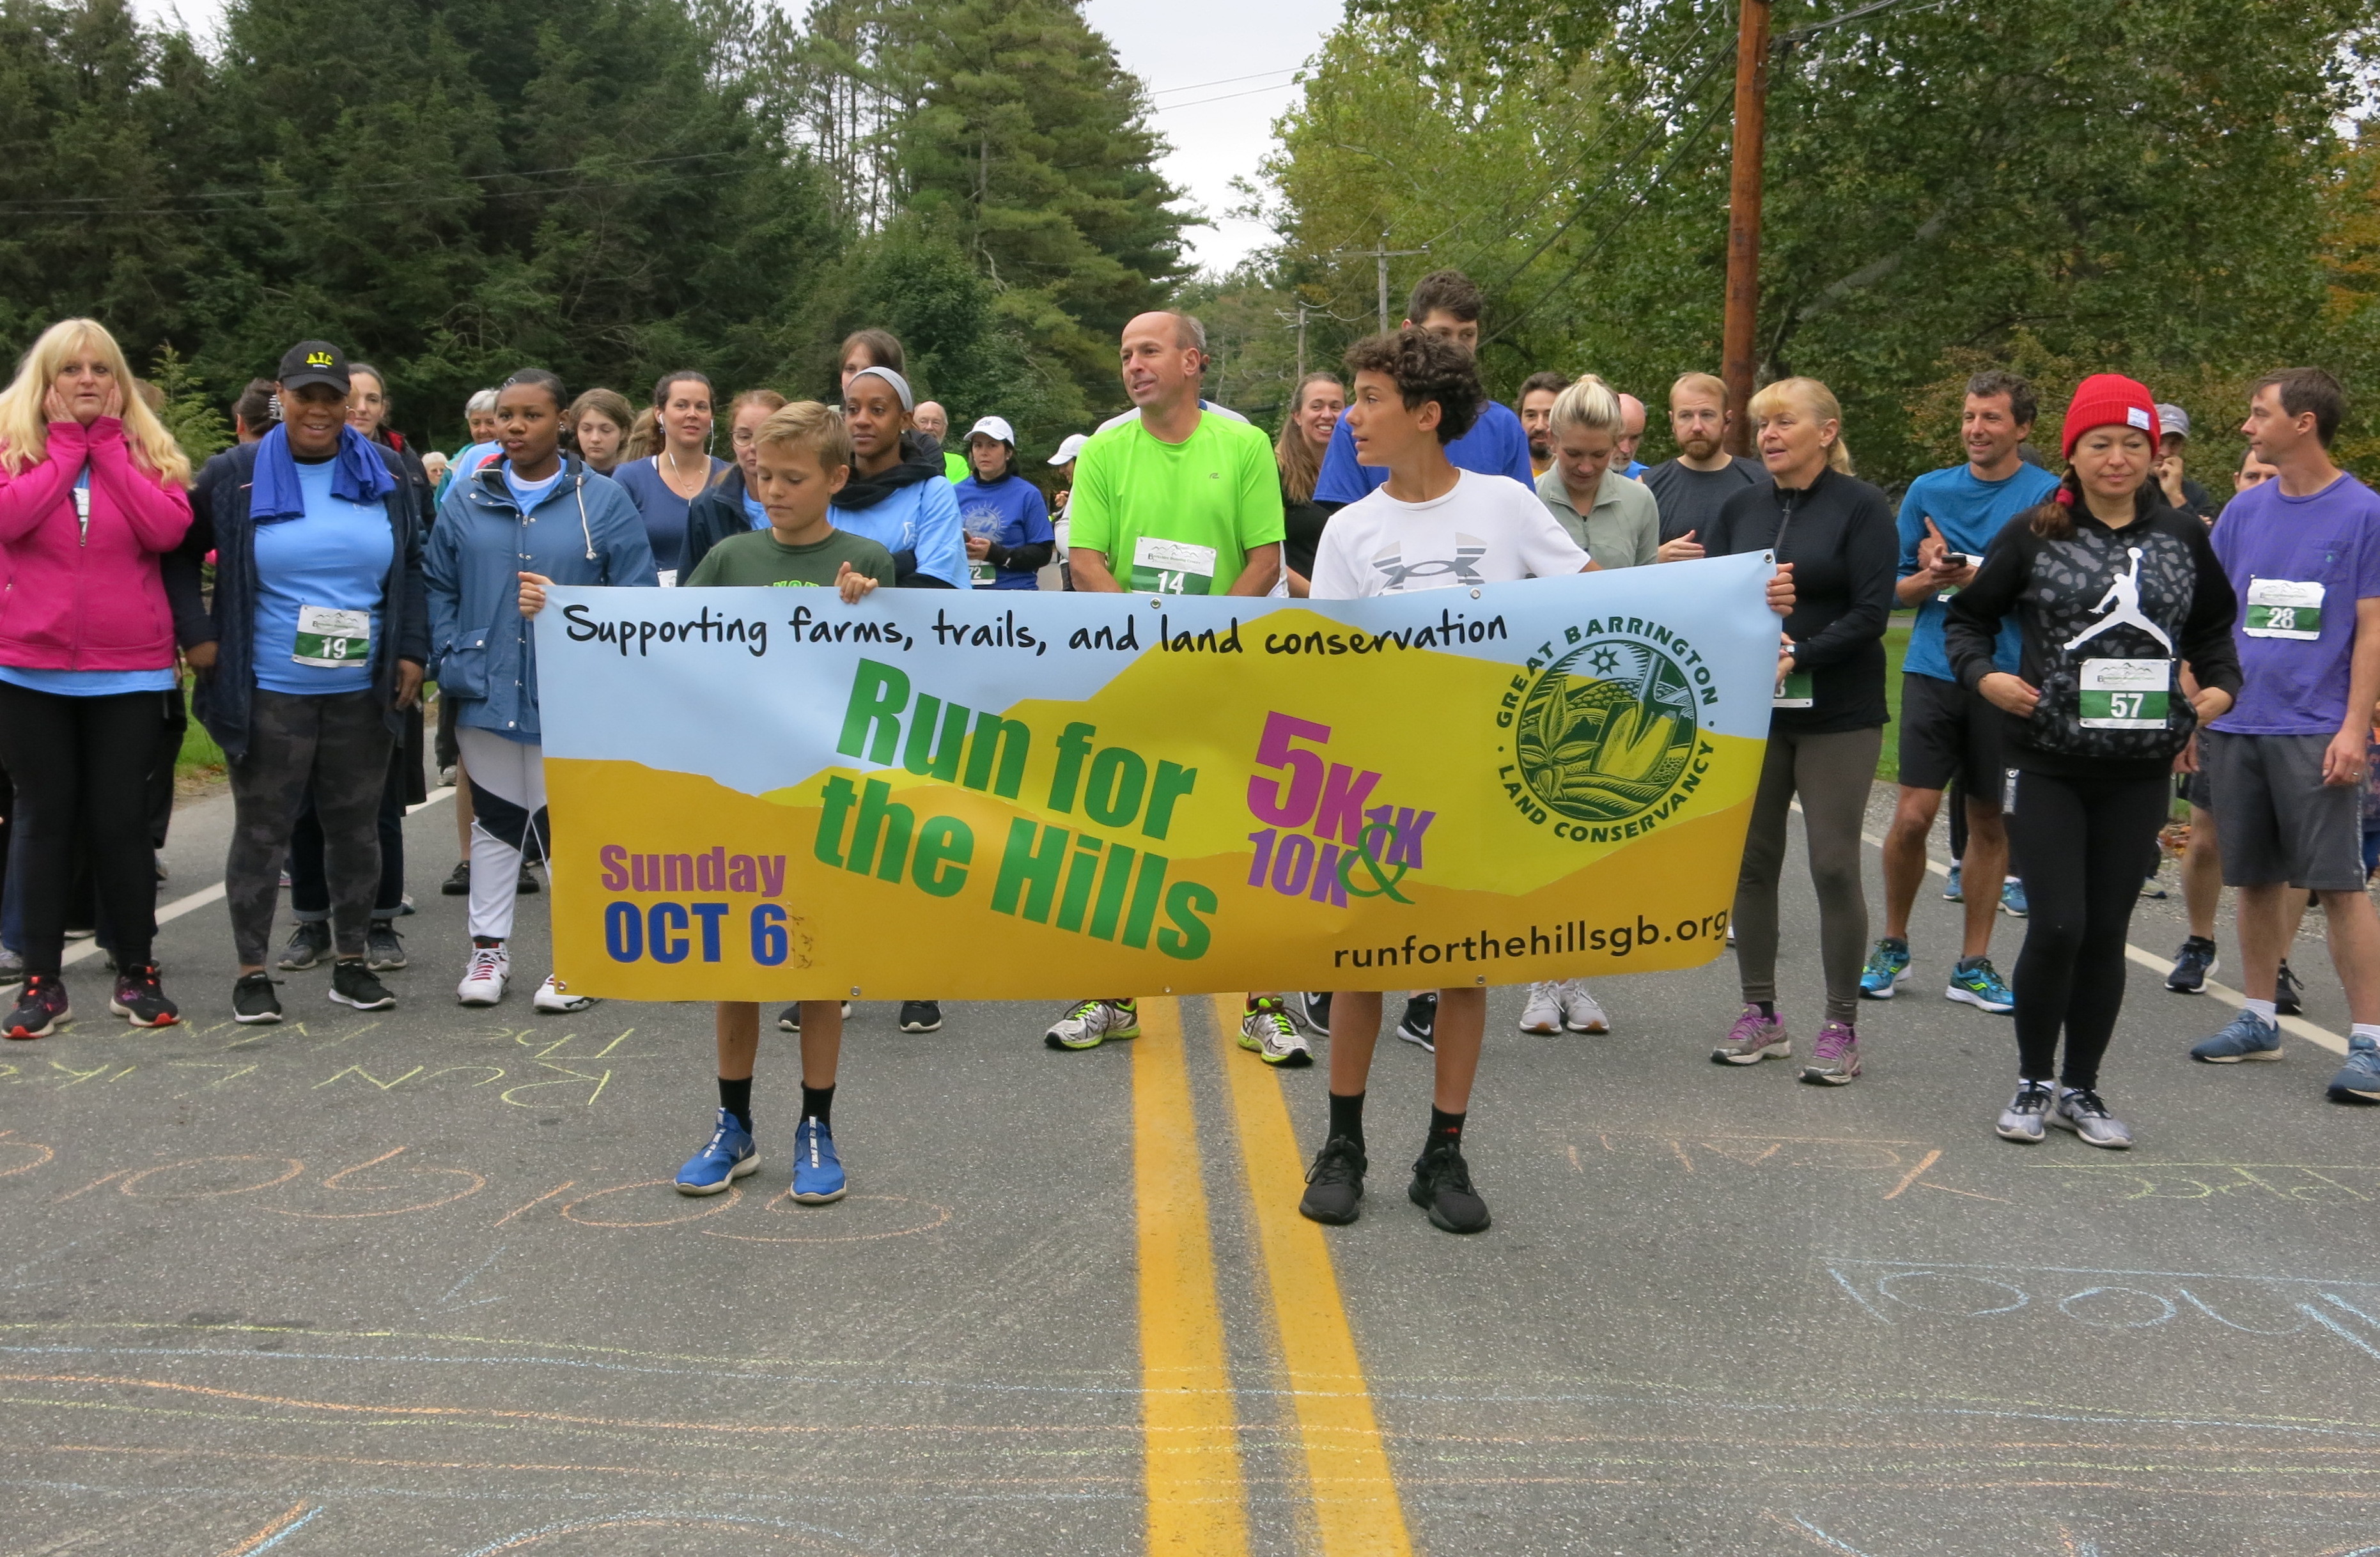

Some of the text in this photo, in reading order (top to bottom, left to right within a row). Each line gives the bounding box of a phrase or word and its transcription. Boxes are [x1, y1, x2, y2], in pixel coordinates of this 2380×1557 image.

[1158, 571, 1185, 595] 14
[321, 637, 347, 659] 19
[563, 604, 1507, 657] Supporting farms, trails, and land conservation
[2267, 607, 2296, 629] 28
[1497, 616, 1719, 729] GREAT BARRINGTON
[2110, 693, 2143, 718] 57
[836, 658, 1198, 840] Run for
[1247, 710, 1382, 846] 5K
[1498, 739, 1715, 843] LAND CONSERVANCY
[600, 844, 786, 897] Sunday
[814, 775, 1218, 961] the Hills
[1247, 803, 1436, 909] 10K & 1K
[605, 901, 729, 963] OCT
[751, 904, 788, 966] 6
[1334, 908, 1728, 968] runforthehillsgb.org
